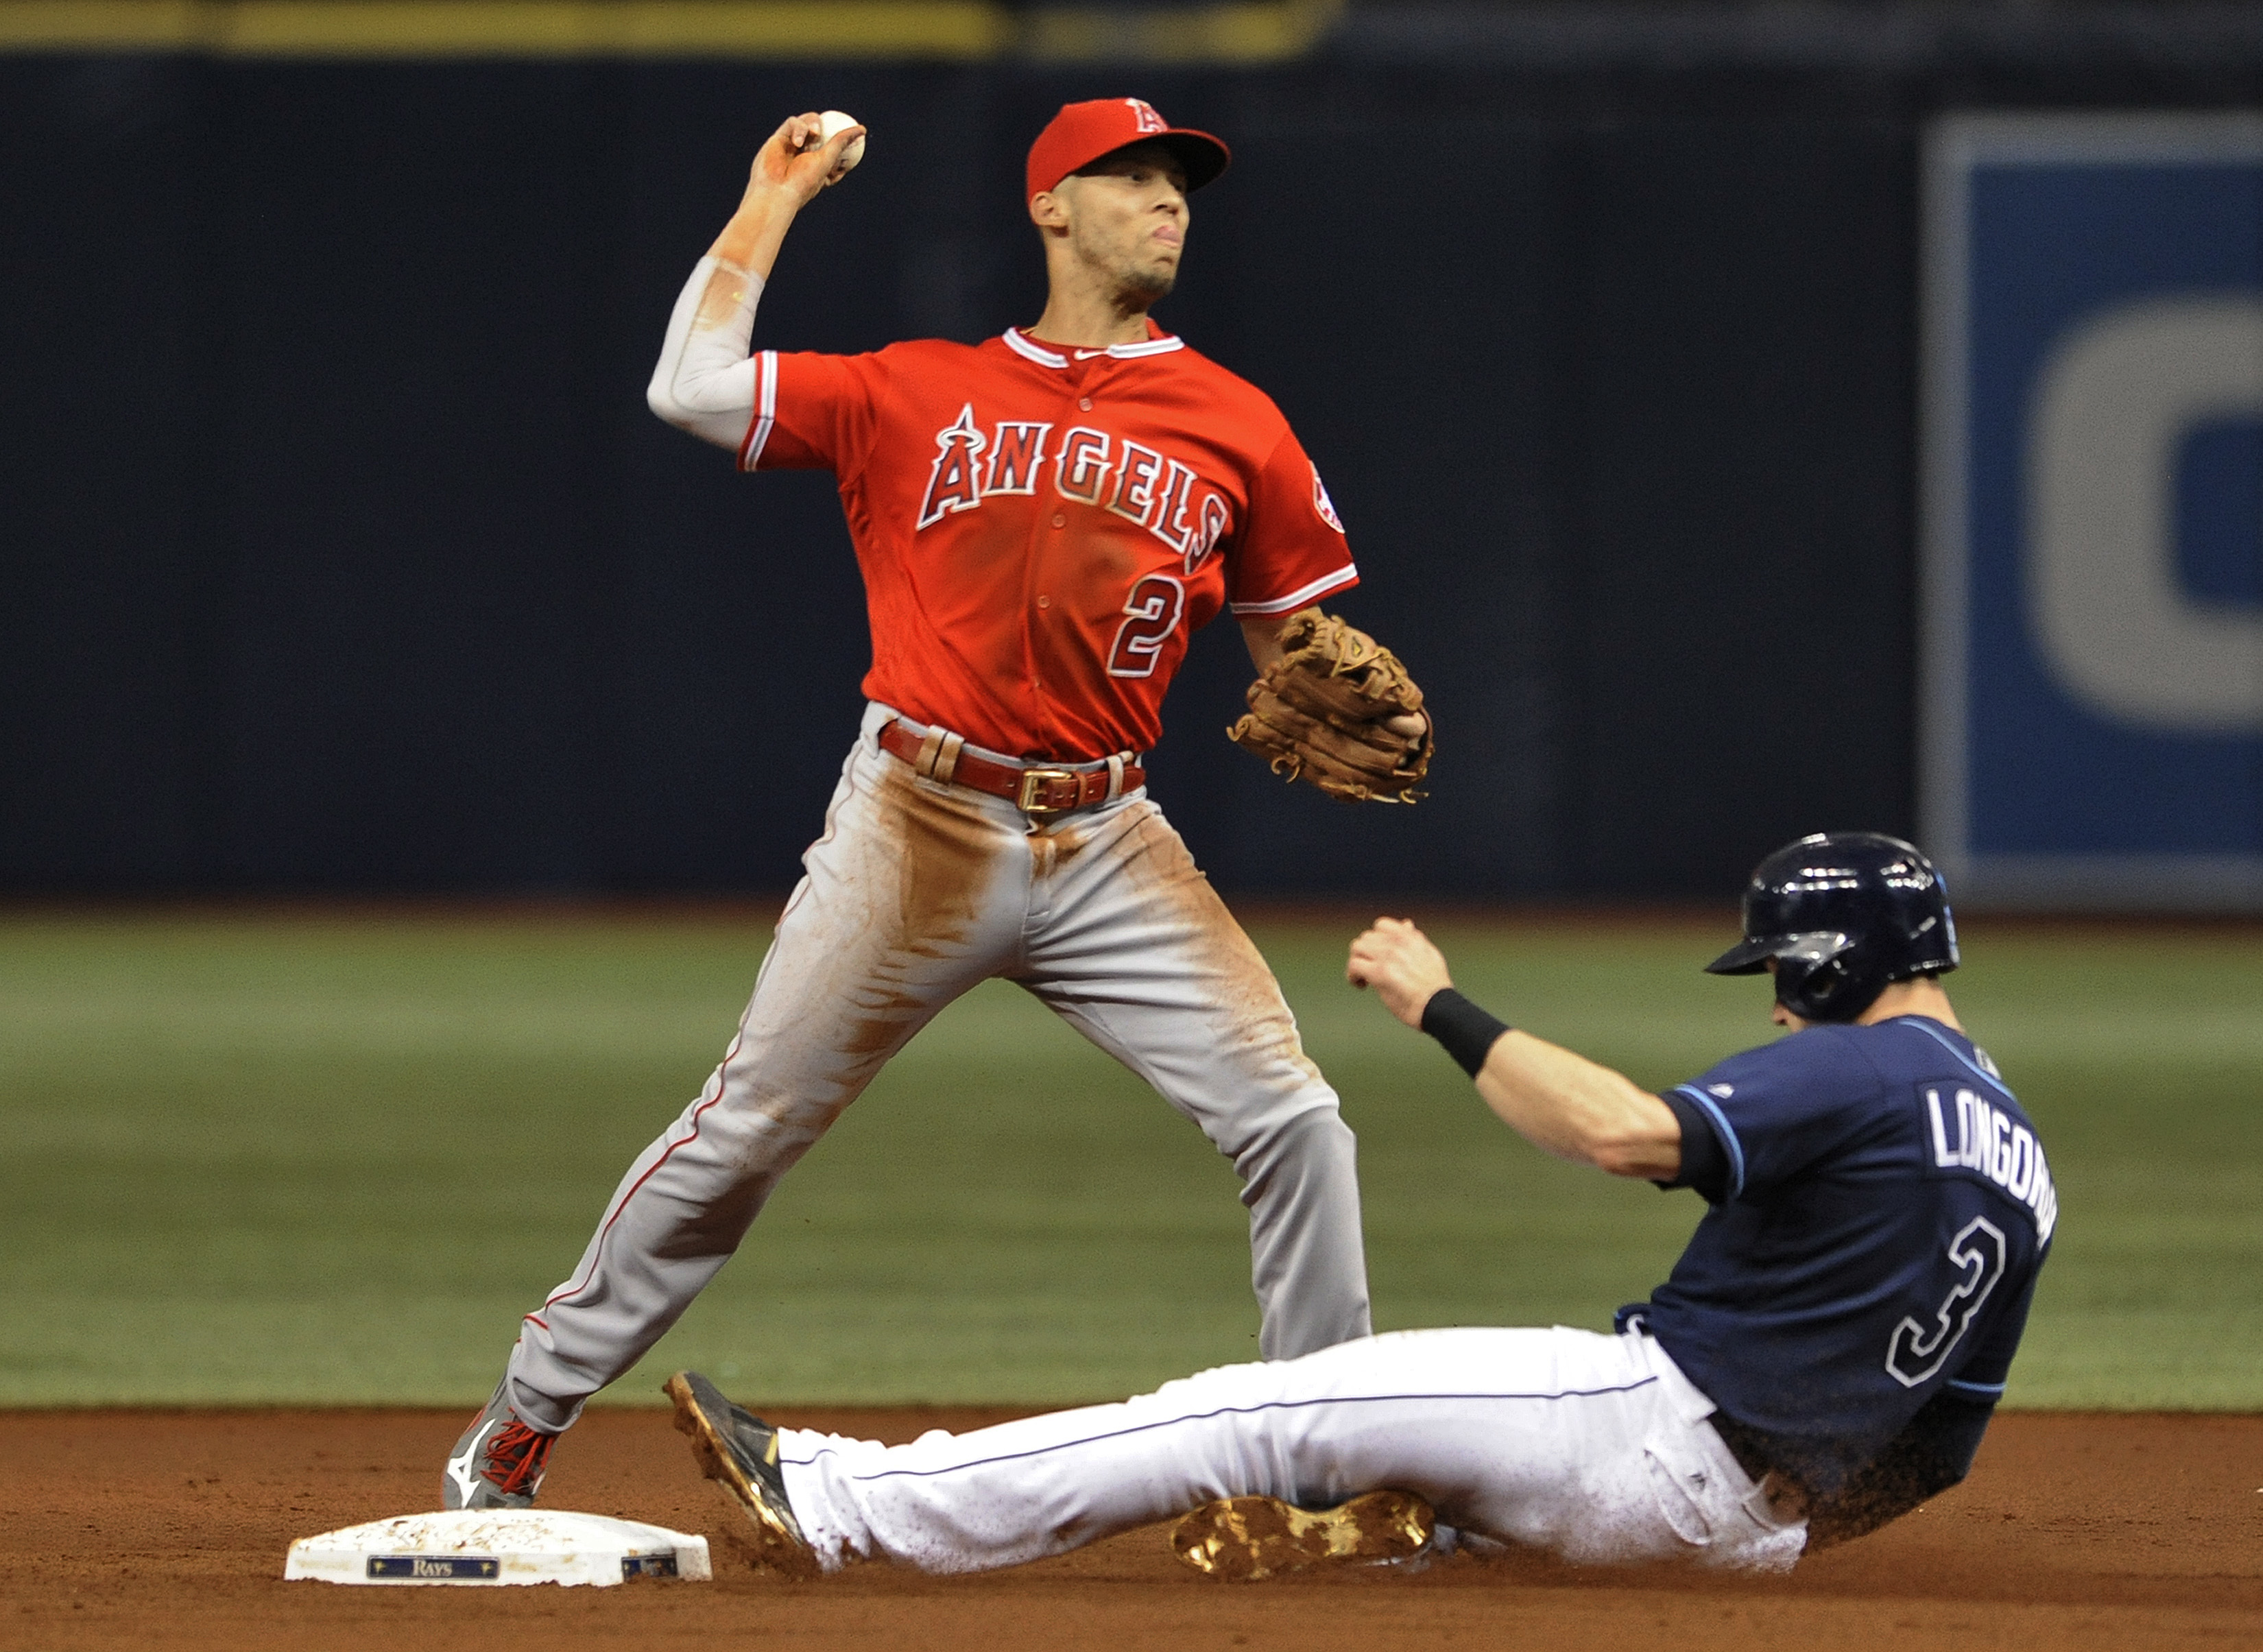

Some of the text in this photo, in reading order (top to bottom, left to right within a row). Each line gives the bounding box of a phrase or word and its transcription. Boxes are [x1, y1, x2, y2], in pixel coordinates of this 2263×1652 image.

[917, 402, 1228, 575] ANGELS
[1107, 574, 1185, 678] 2
[1885, 1216, 2006, 1387] 3
